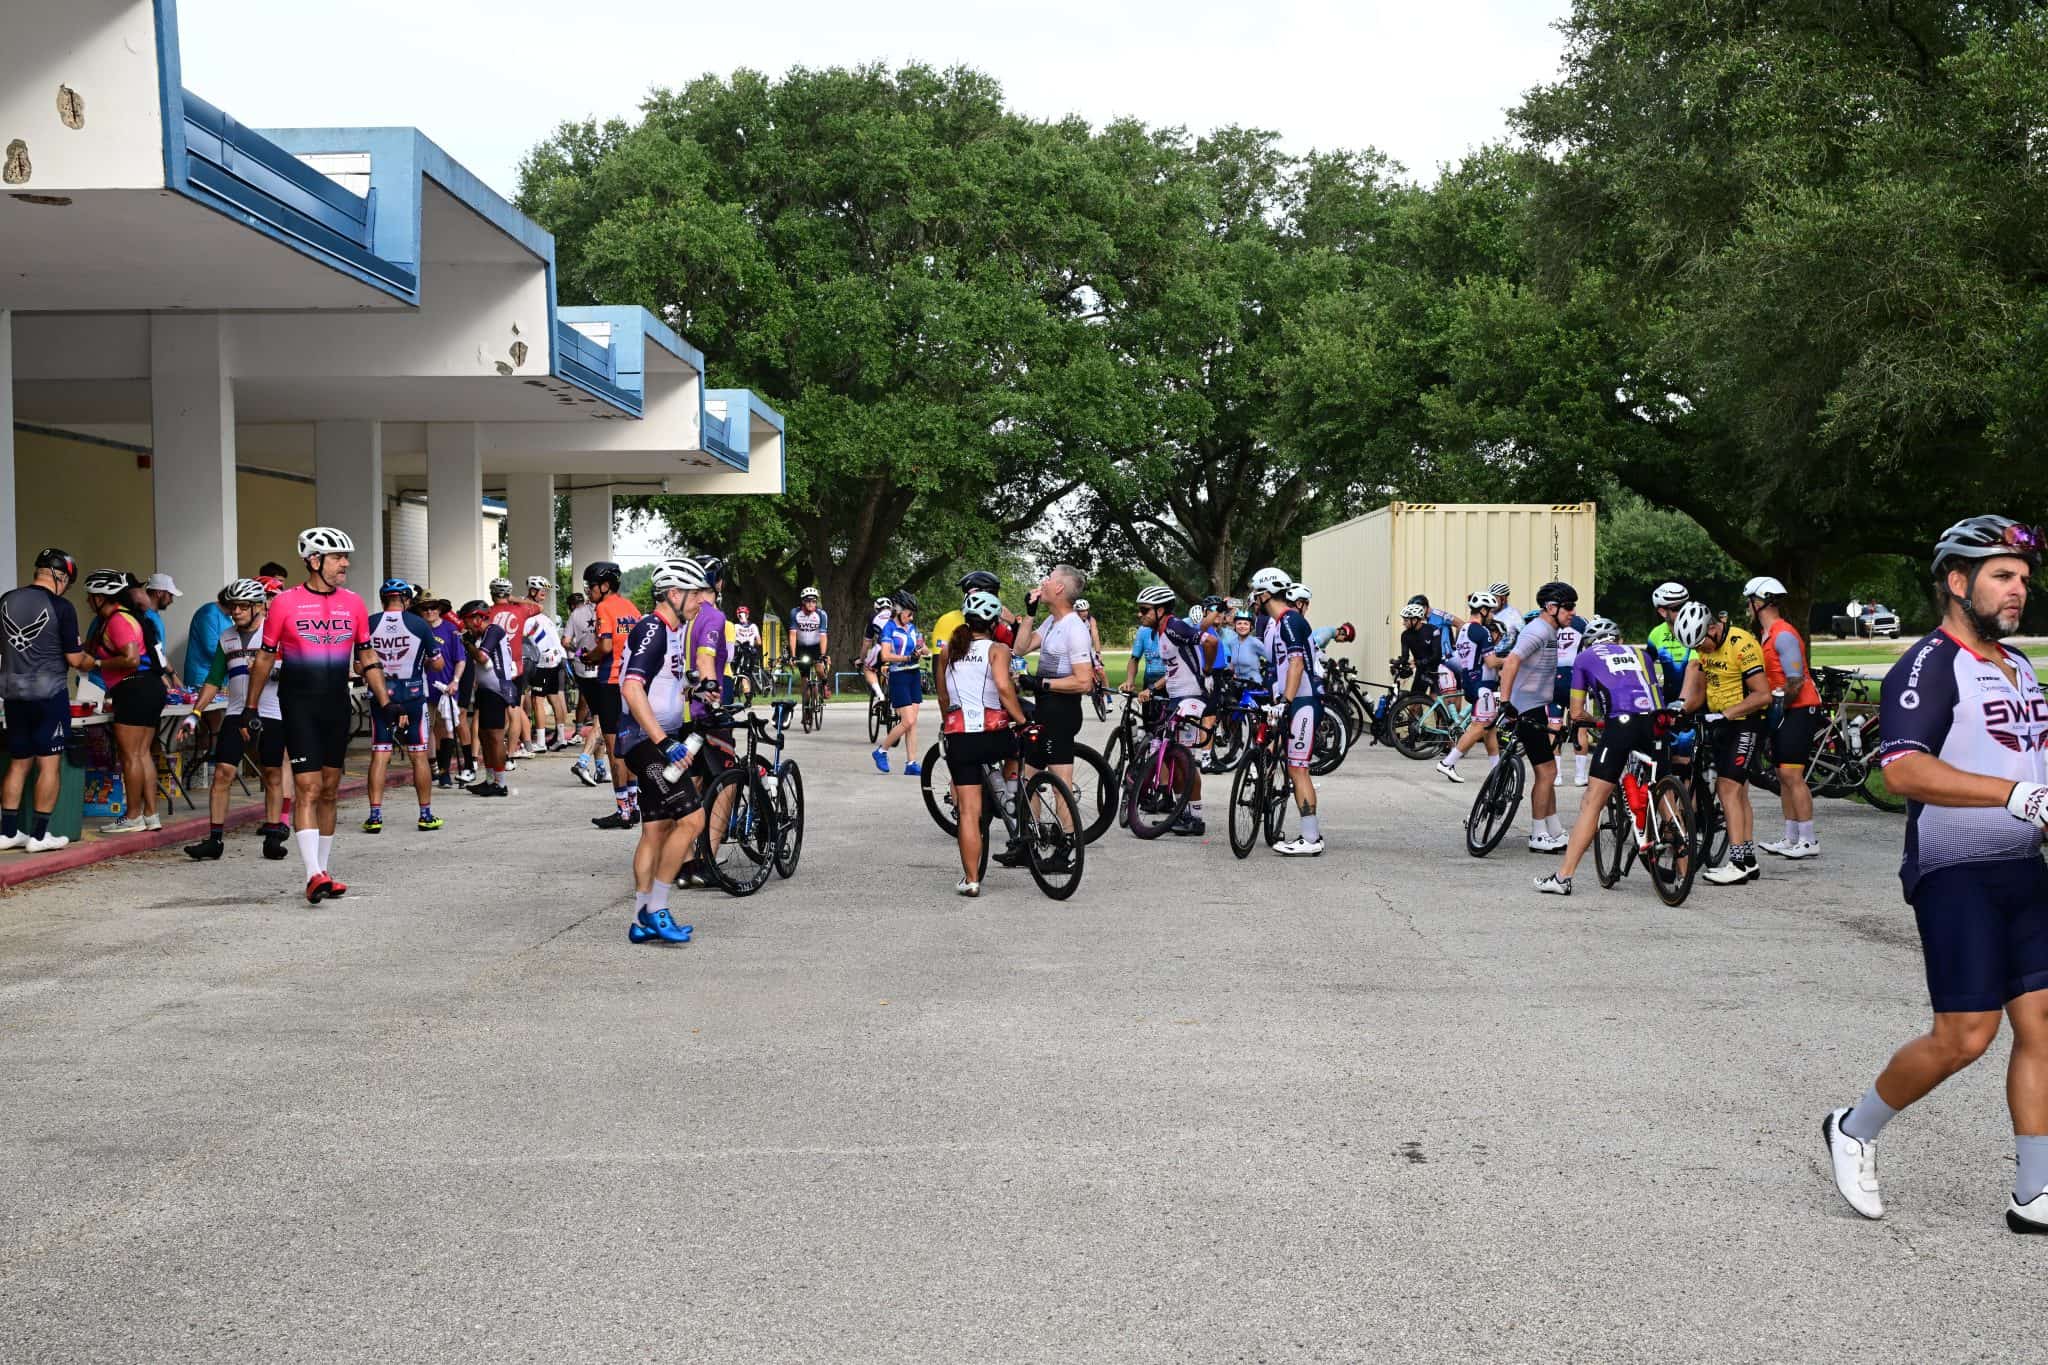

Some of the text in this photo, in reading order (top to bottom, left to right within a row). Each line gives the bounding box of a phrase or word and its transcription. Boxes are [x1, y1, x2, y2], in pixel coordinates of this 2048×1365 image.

[295, 619, 353, 631] SWCC
[373, 636, 410, 649] SWCC
[635, 622, 660, 657] wood
[1612, 656, 1636, 665] 904
[1908, 645, 1934, 688] EXPRO
[1982, 699, 2048, 726] SWC
